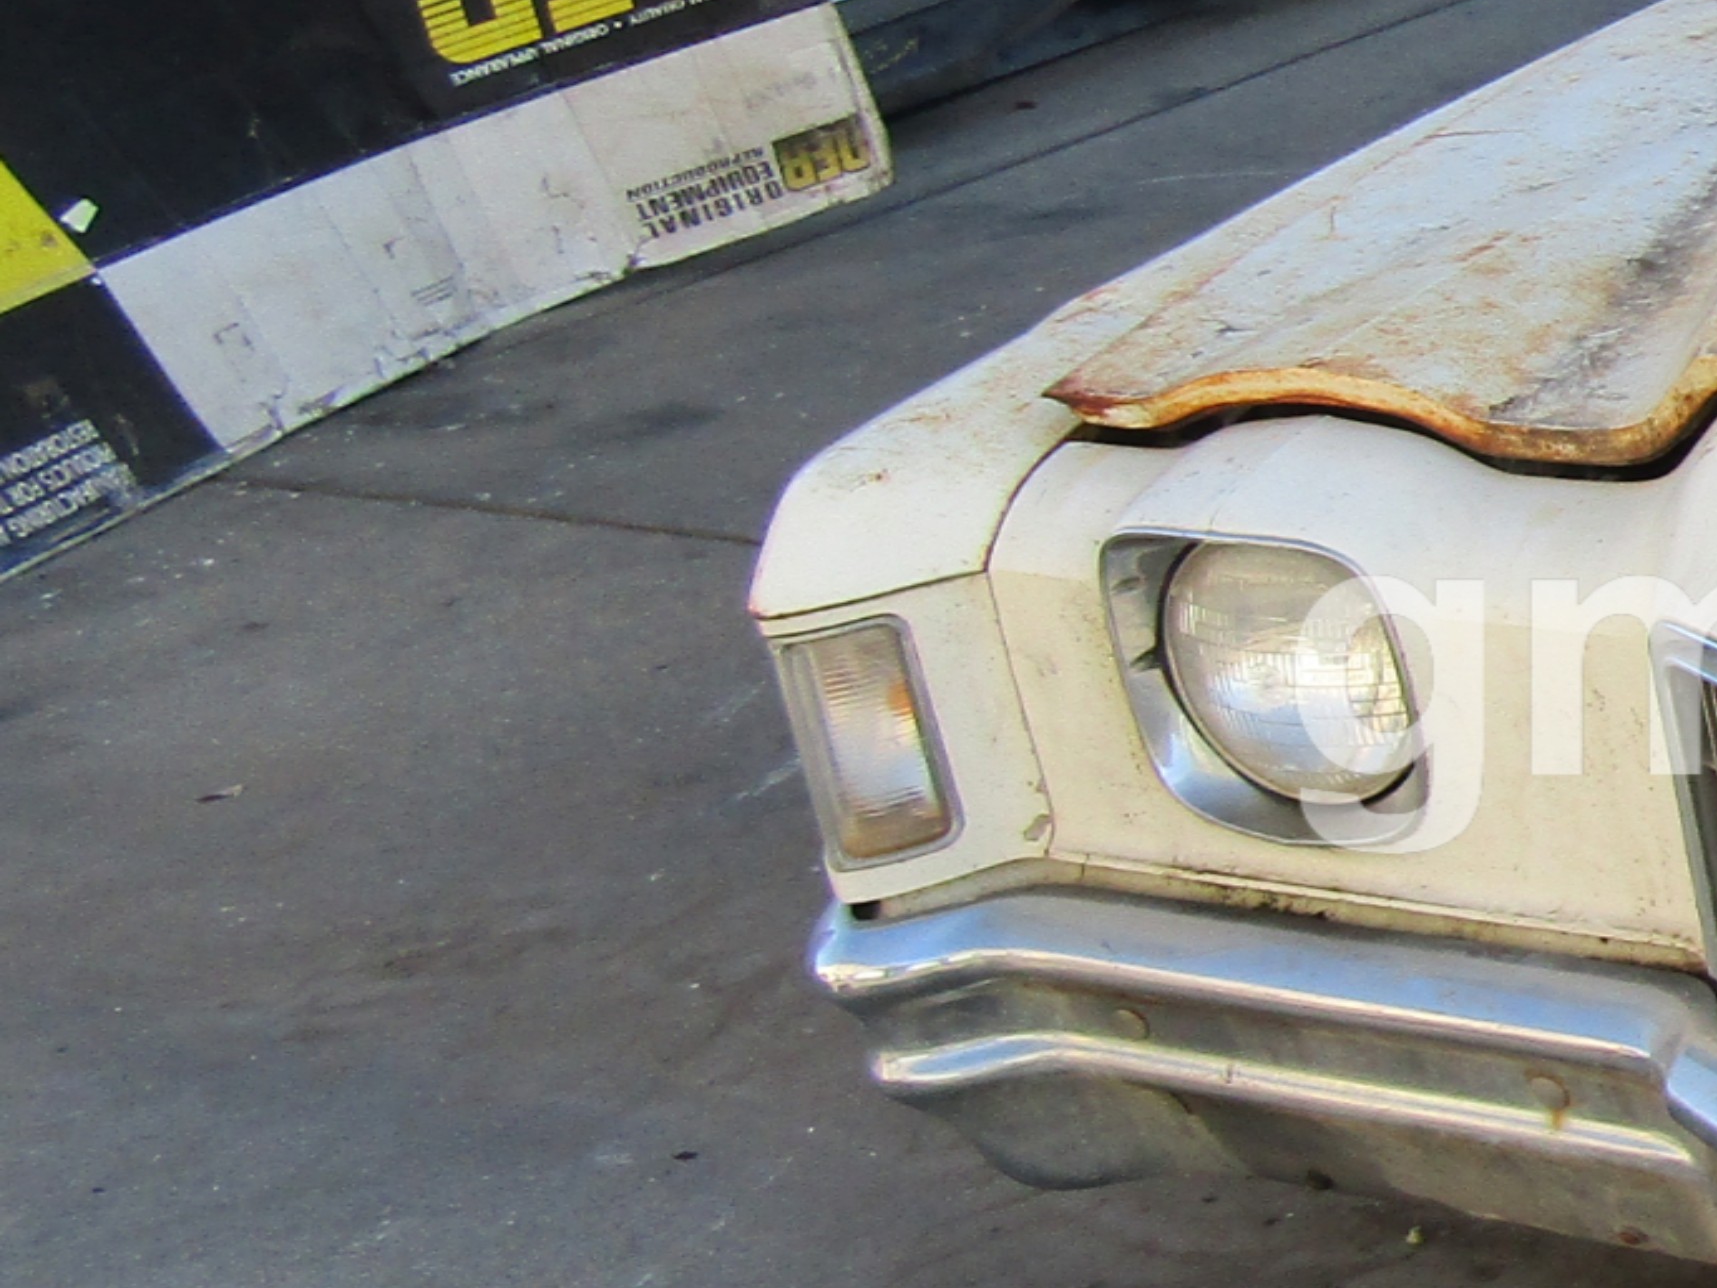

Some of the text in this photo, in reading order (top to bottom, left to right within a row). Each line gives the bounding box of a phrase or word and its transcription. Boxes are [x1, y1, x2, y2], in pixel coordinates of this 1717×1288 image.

[540, 21, 611, 56] ORIGINAL
[449, 46, 539, 87] APPEARANCE
[624, 146, 765, 200] REPRODUCTION
[634, 160, 774, 221] EQUIPMENT
[643, 182, 784, 240] ORIGINAL
